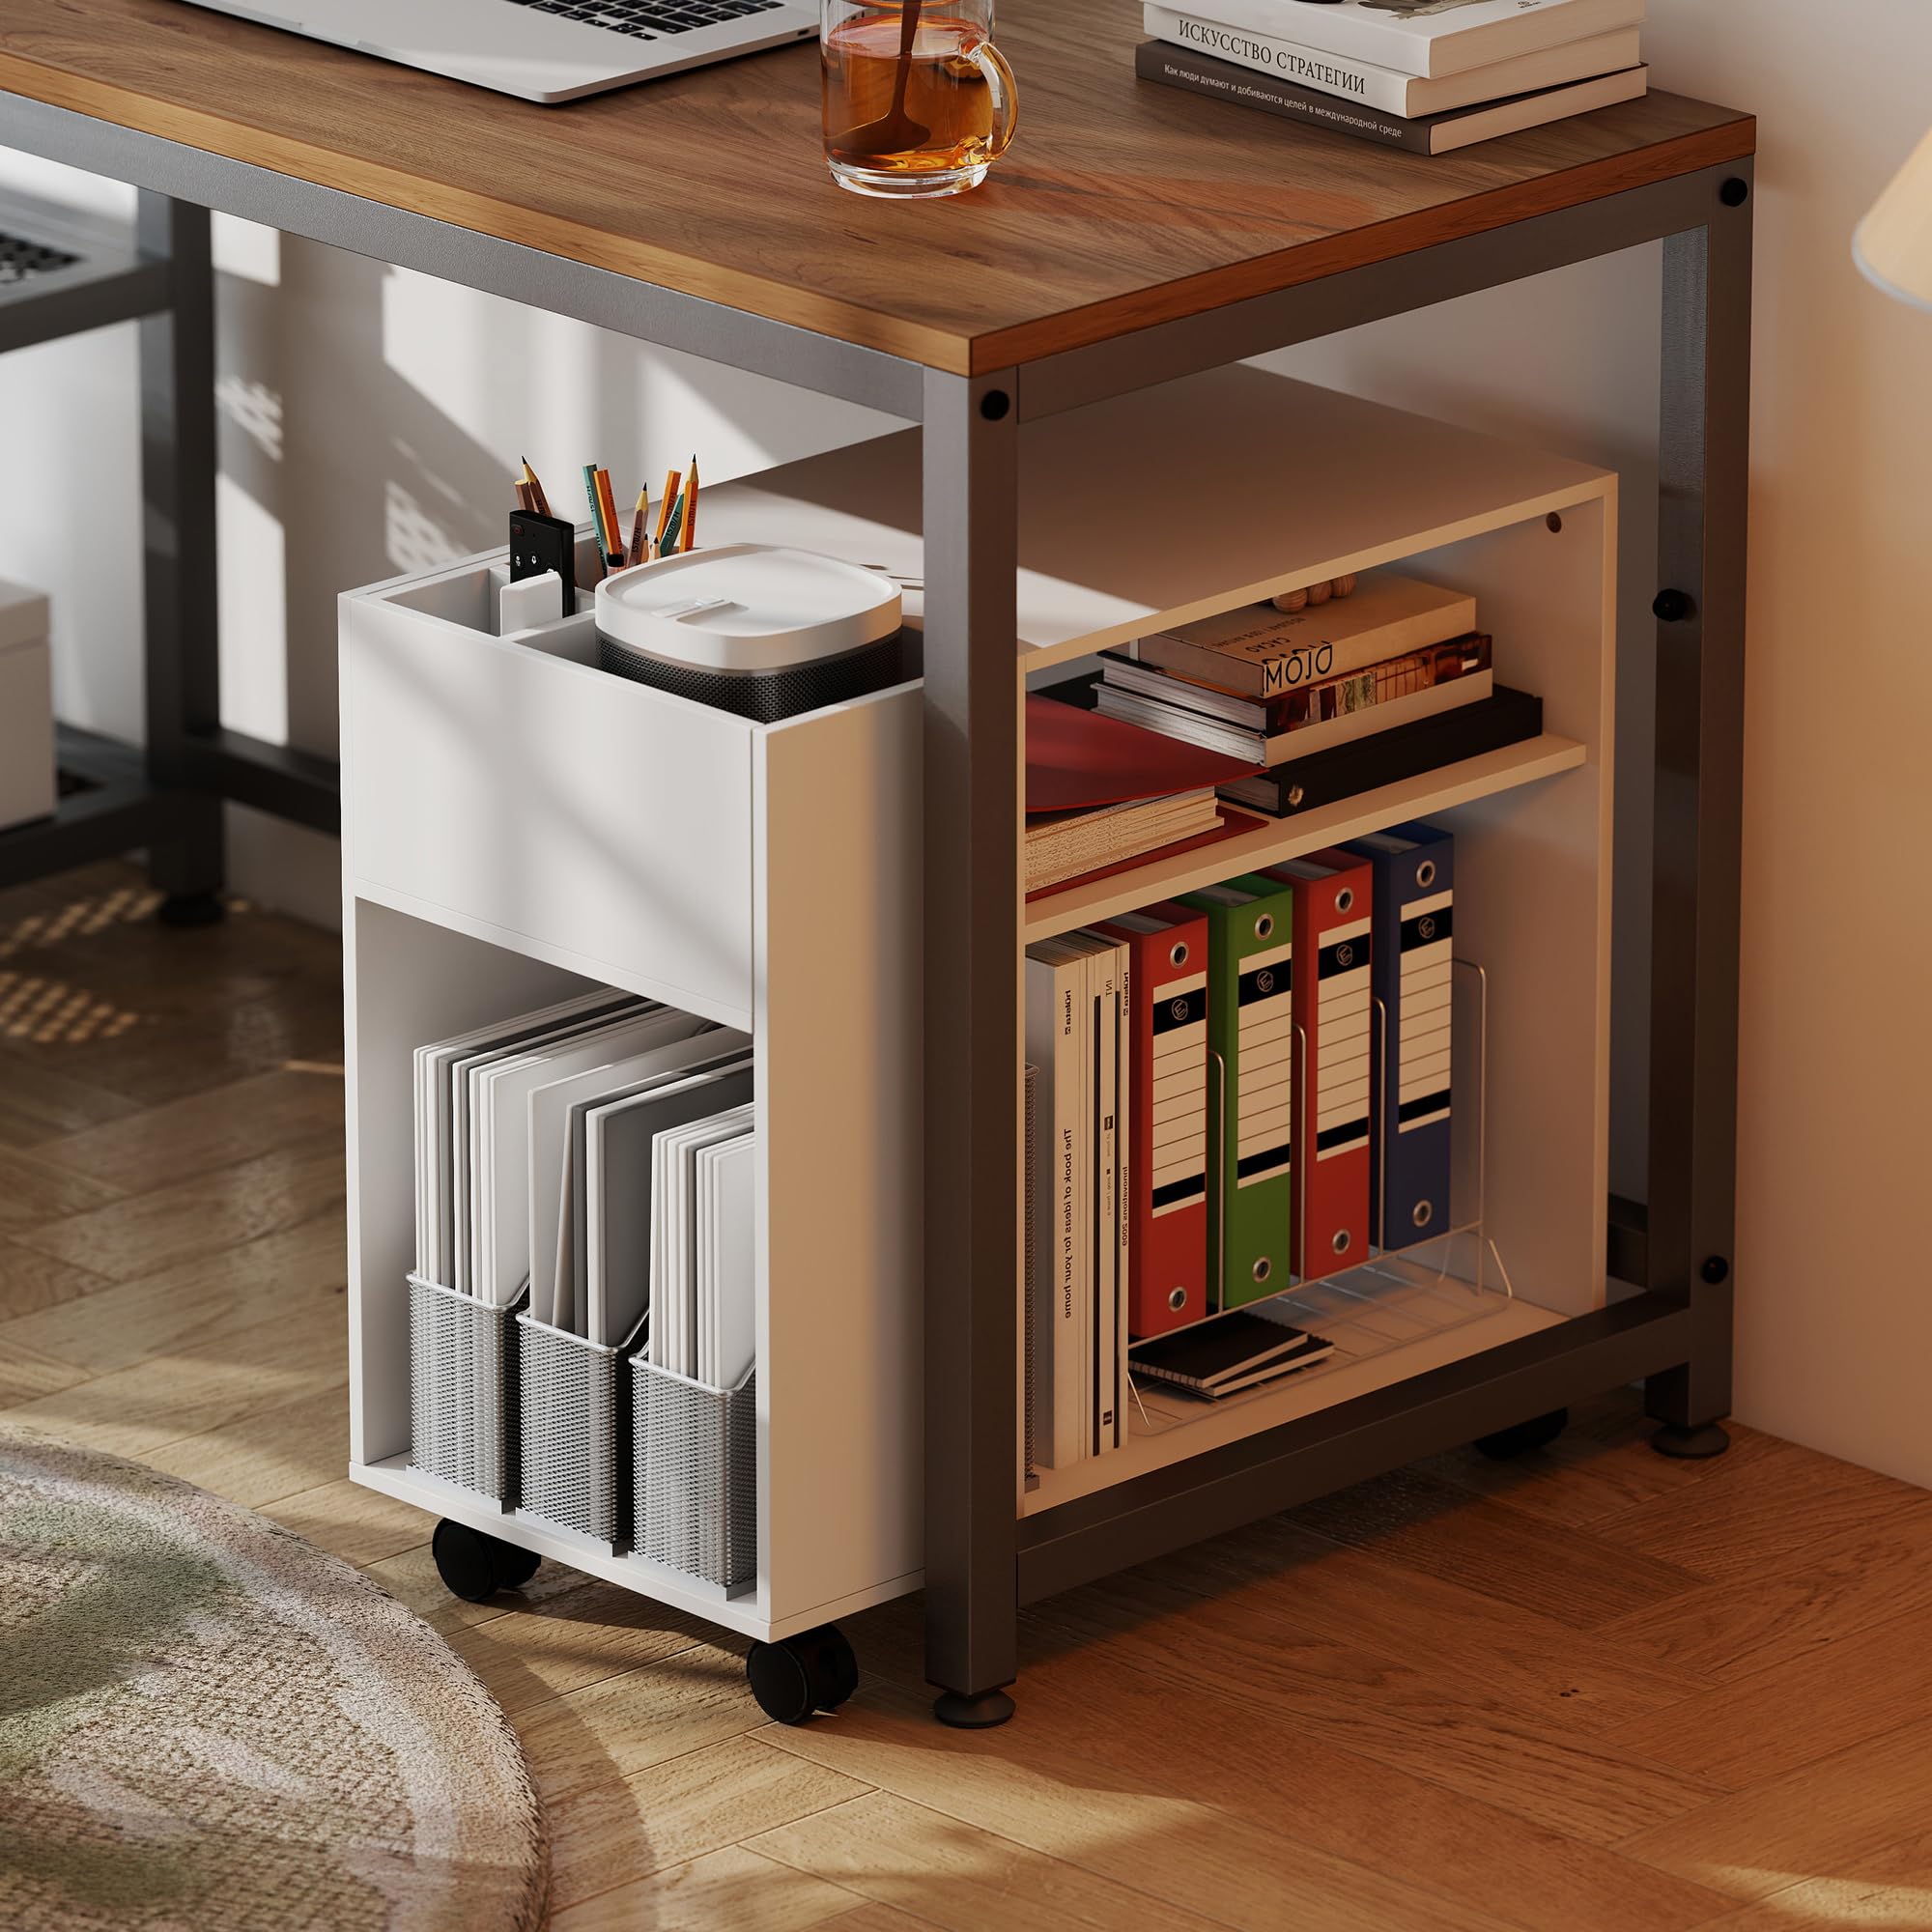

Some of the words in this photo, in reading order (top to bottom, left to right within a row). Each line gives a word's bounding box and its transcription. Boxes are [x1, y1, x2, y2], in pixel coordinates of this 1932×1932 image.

[1179, 20, 1272, 64] ИСКУССТВО
[1276, 51, 1366, 95] СТРАТЕГИИ
[1165, 64, 1178, 75] Как
[1179, 67, 1199, 81] люди
[1201, 73, 1229, 92] думают
[1237, 85, 1283, 105] добиваются
[1284, 97, 1307, 113] целей
[1316, 106, 1378, 131] международной
[1378, 123, 1402, 138] среде
